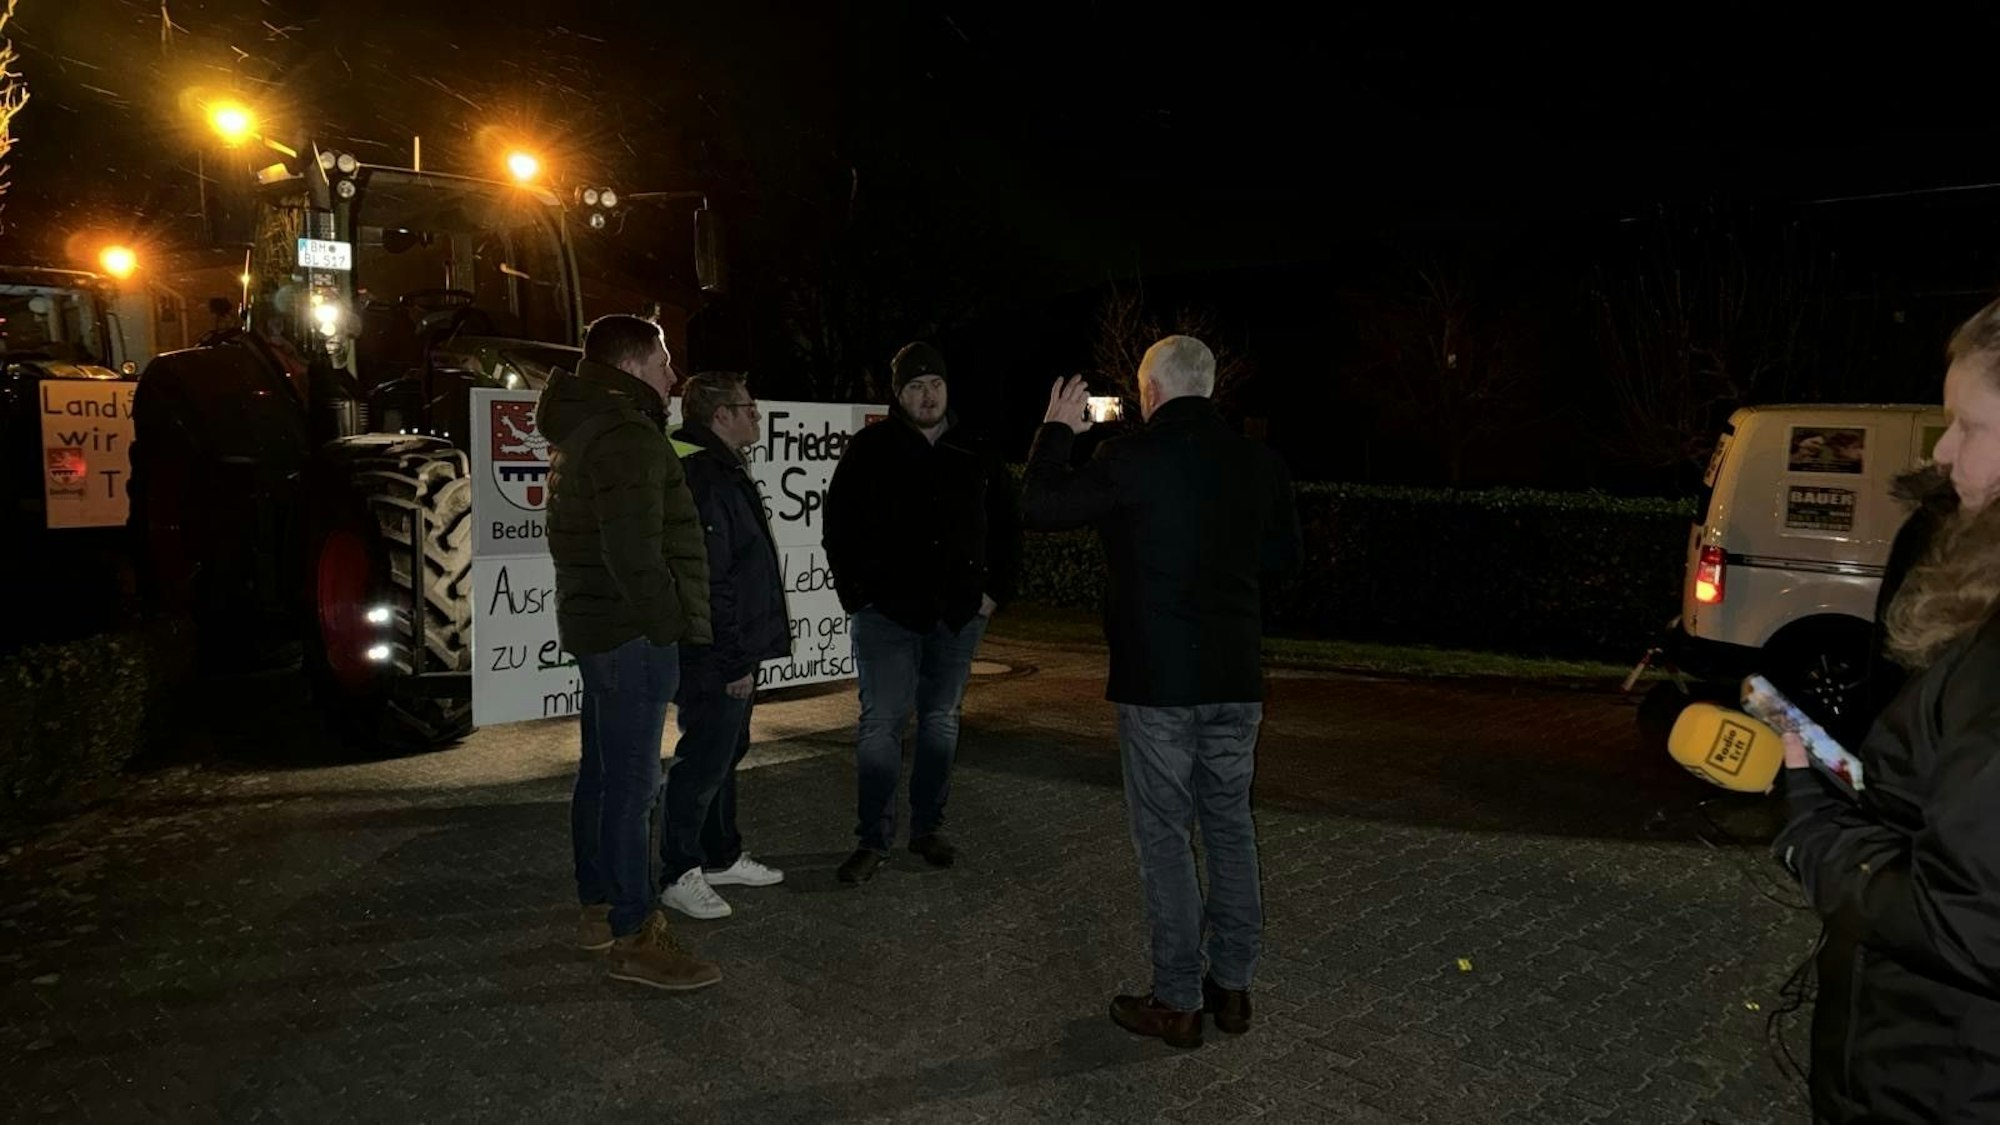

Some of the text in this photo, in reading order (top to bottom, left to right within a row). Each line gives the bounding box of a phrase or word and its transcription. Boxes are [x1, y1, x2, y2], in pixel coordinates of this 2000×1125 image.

[56, 427, 118, 452] wir
[1790, 491, 1854, 506] BAUER
[491, 645, 527, 671] zu
[543, 679, 583, 717] mit
[1714, 729, 1737, 762] Radio
